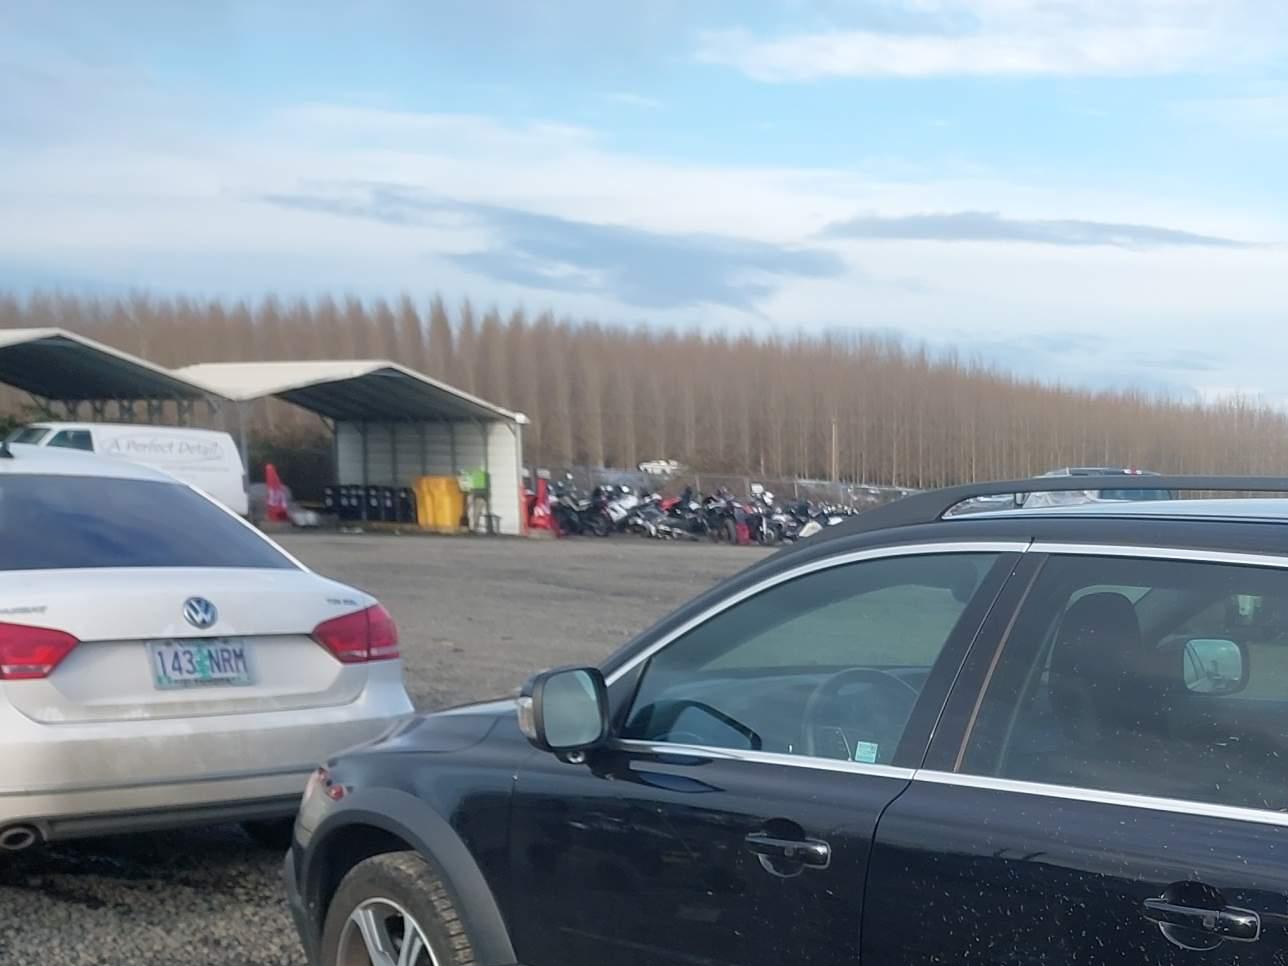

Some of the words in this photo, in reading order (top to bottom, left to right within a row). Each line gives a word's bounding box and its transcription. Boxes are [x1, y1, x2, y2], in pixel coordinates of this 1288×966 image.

[126, 438, 174, 456] Perfect
[157, 649, 198, 677] 143
[207, 647, 249, 674] NRM
